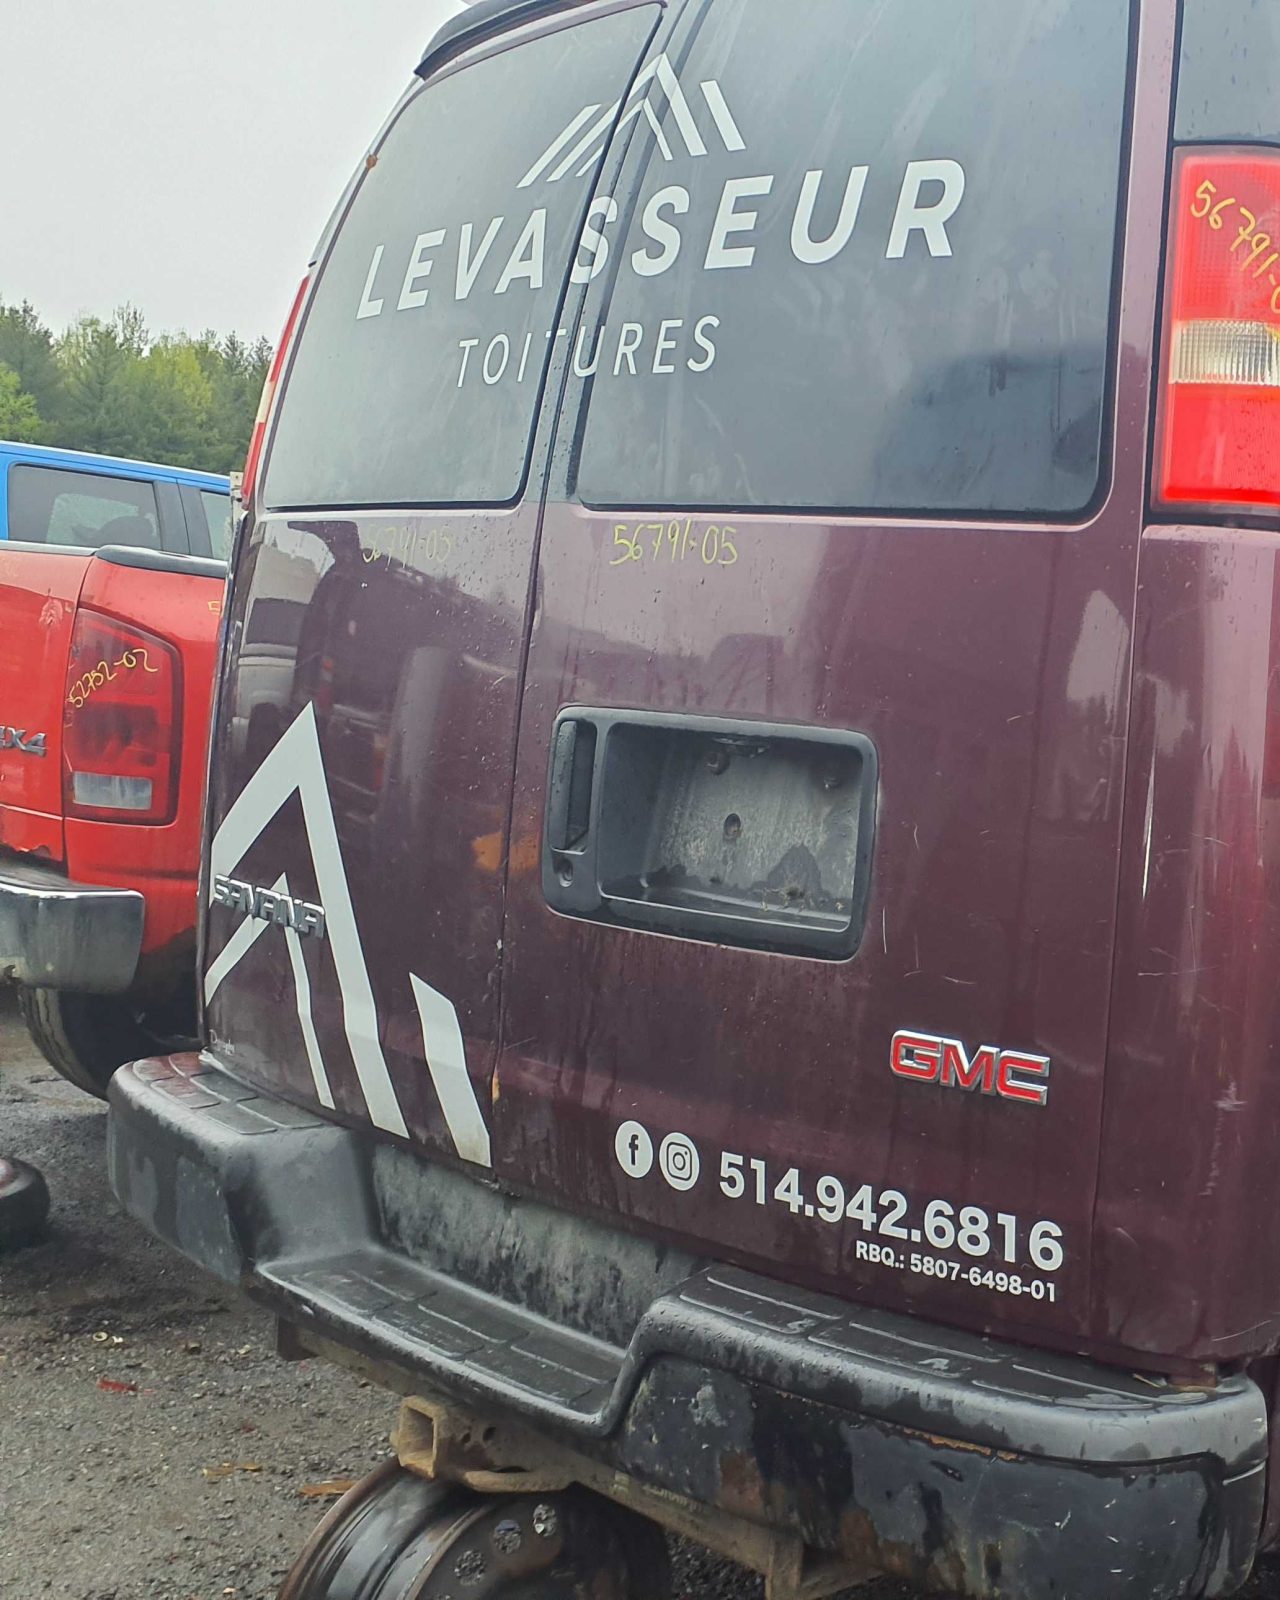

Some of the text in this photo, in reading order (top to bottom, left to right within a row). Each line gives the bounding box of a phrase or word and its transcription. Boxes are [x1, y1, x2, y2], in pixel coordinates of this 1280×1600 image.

[356, 158, 966, 320] LEVASSEUR
[609, 519, 739, 565] 56791-05
[0, 725, 47, 758] X4
[889, 1029, 1051, 1106] GMC
[719, 1151, 1064, 1272] 514.942.6816
[855, 1239, 1056, 1303] RBQ.: 5807-6498-01
